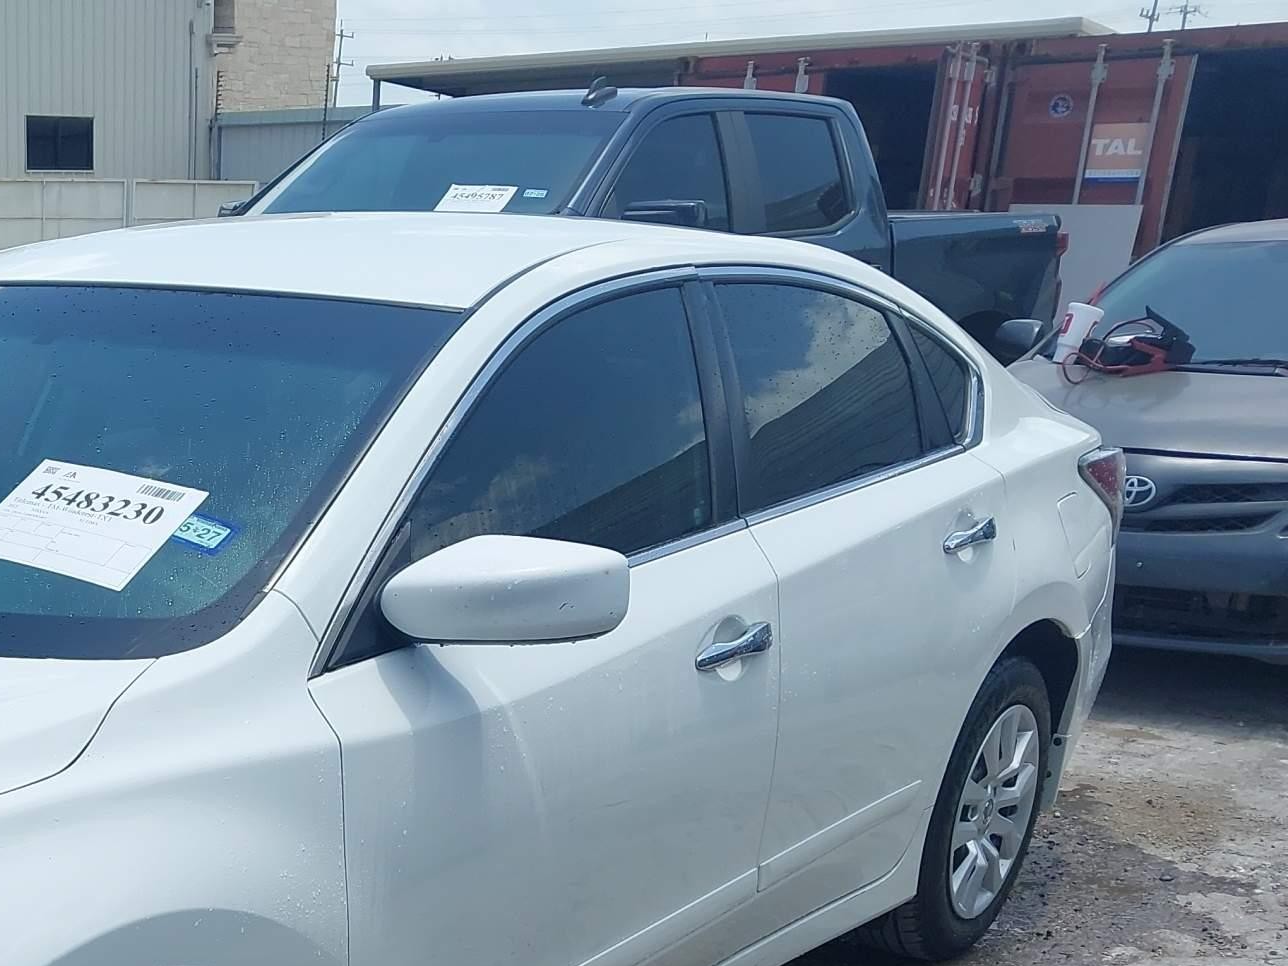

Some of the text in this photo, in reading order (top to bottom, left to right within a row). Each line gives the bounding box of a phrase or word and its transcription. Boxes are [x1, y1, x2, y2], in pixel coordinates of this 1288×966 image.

[1092, 138, 1144, 156] TAL
[31, 483, 165, 525] 45483230
[196, 527, 222, 542] 27
